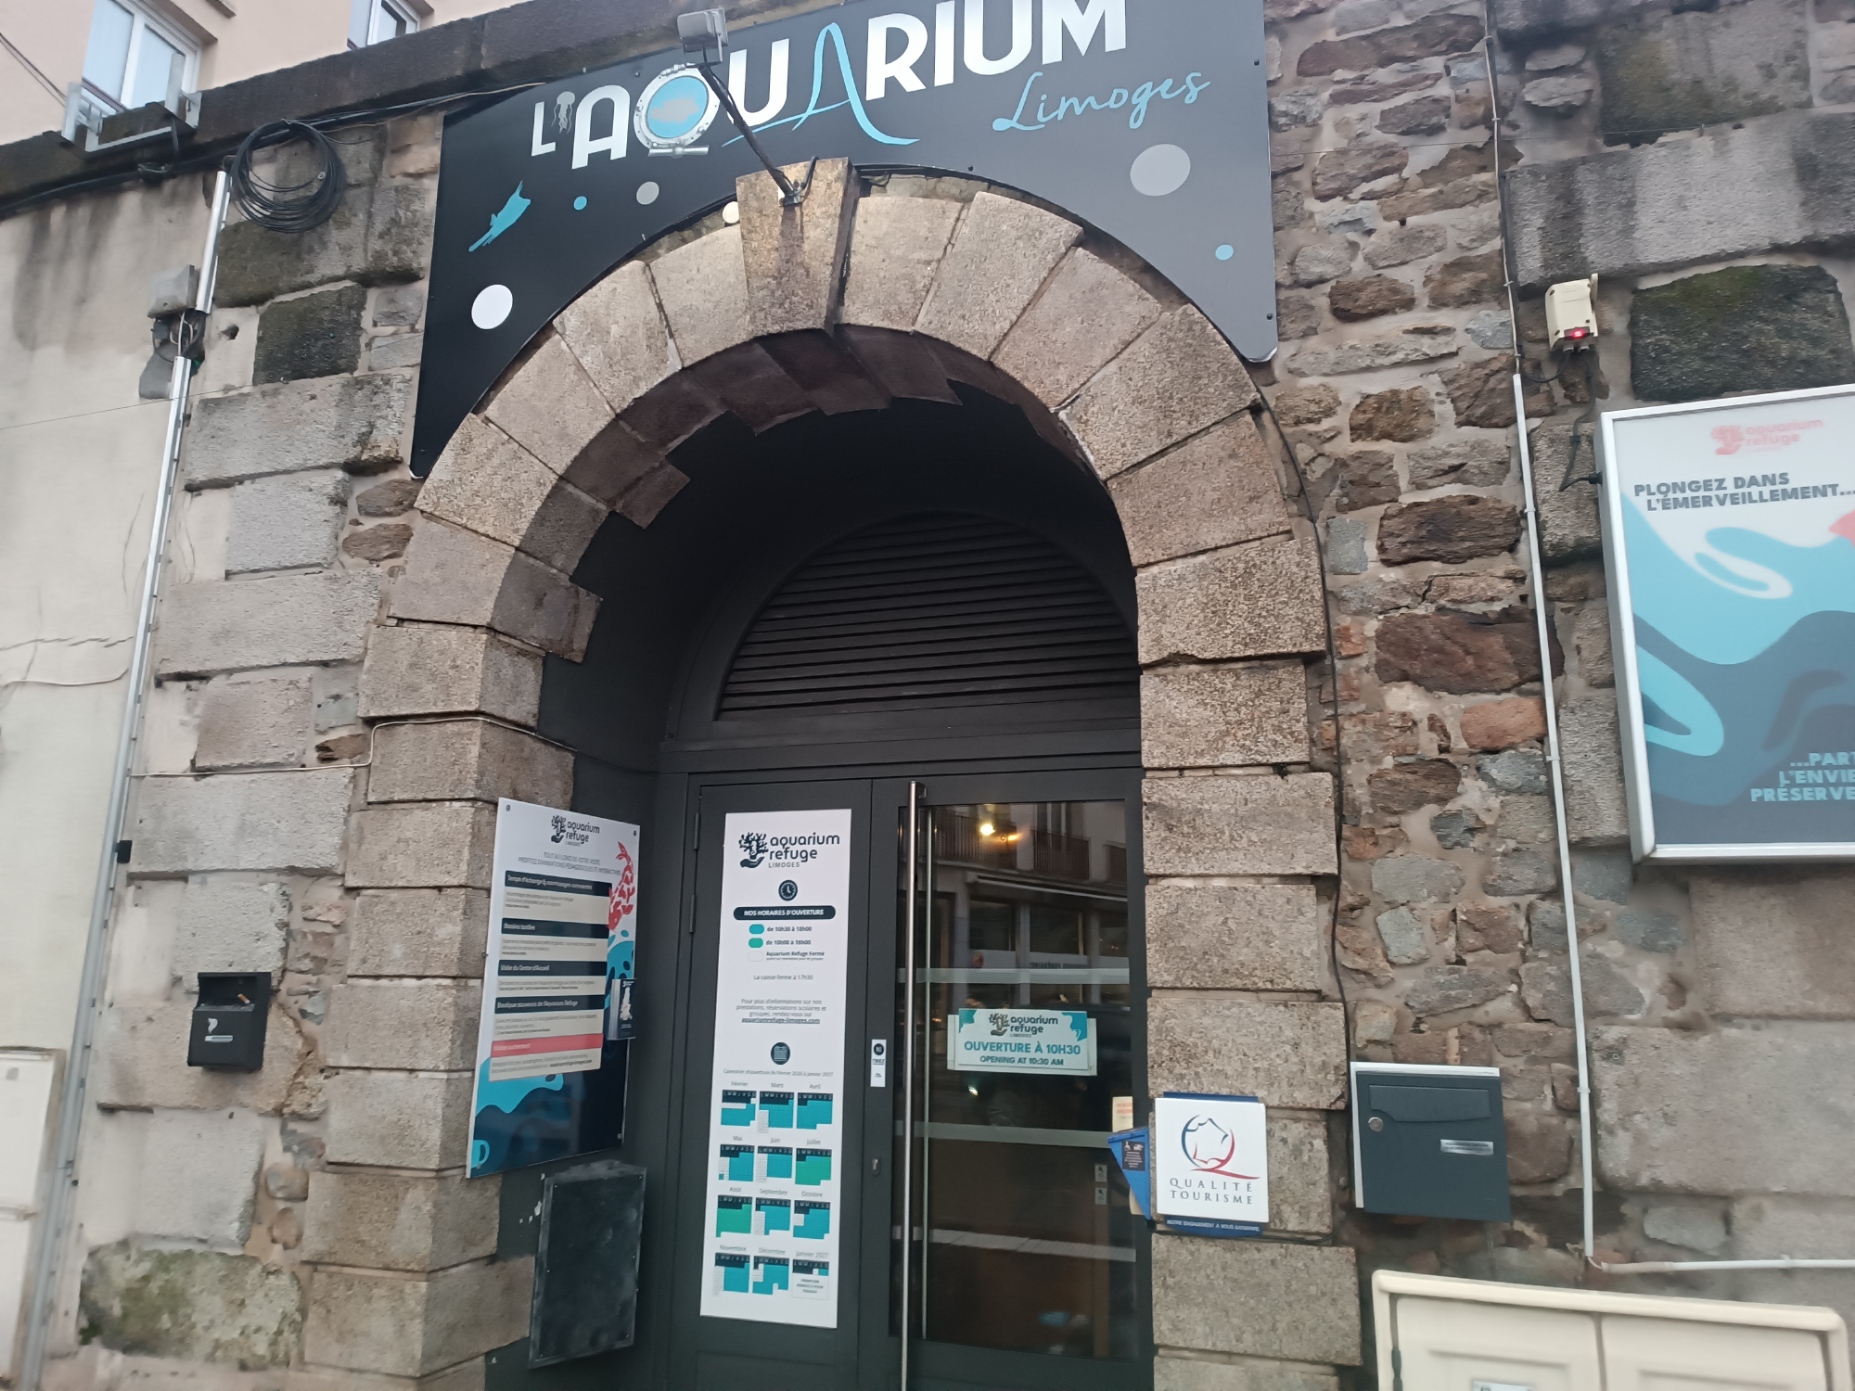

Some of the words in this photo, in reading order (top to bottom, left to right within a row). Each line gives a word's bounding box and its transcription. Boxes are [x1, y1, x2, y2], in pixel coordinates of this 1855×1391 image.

[992, 71, 1210, 131] Limoges
[1746, 420, 1823, 435] aquarium
[1747, 434, 1800, 446] refuge
[1634, 478, 1727, 496] PLONGEZ
[1733, 472, 1789, 490] DANS
[567, 821, 600, 834] aquarium
[565, 831, 589, 844] refuge
[770, 832, 840, 848] aquarium
[769, 846, 818, 863] refuge
[1010, 1015, 1058, 1026] aquarium
[1010, 1024, 1044, 1035] refuge
[964, 1041, 1032, 1053] OUVERTURE
[1035, 1041, 1043, 1054] À
[1046, 1044, 1081, 1055] 10H30
[980, 1056, 1016, 1064] OPENING
[1029, 1057, 1048, 1065] 10:30
[1051, 1058, 1064, 1066] AM
[1170, 1178, 1252, 1192] QUALITÉ
[1170, 1190, 1252, 1204] TOURISME
